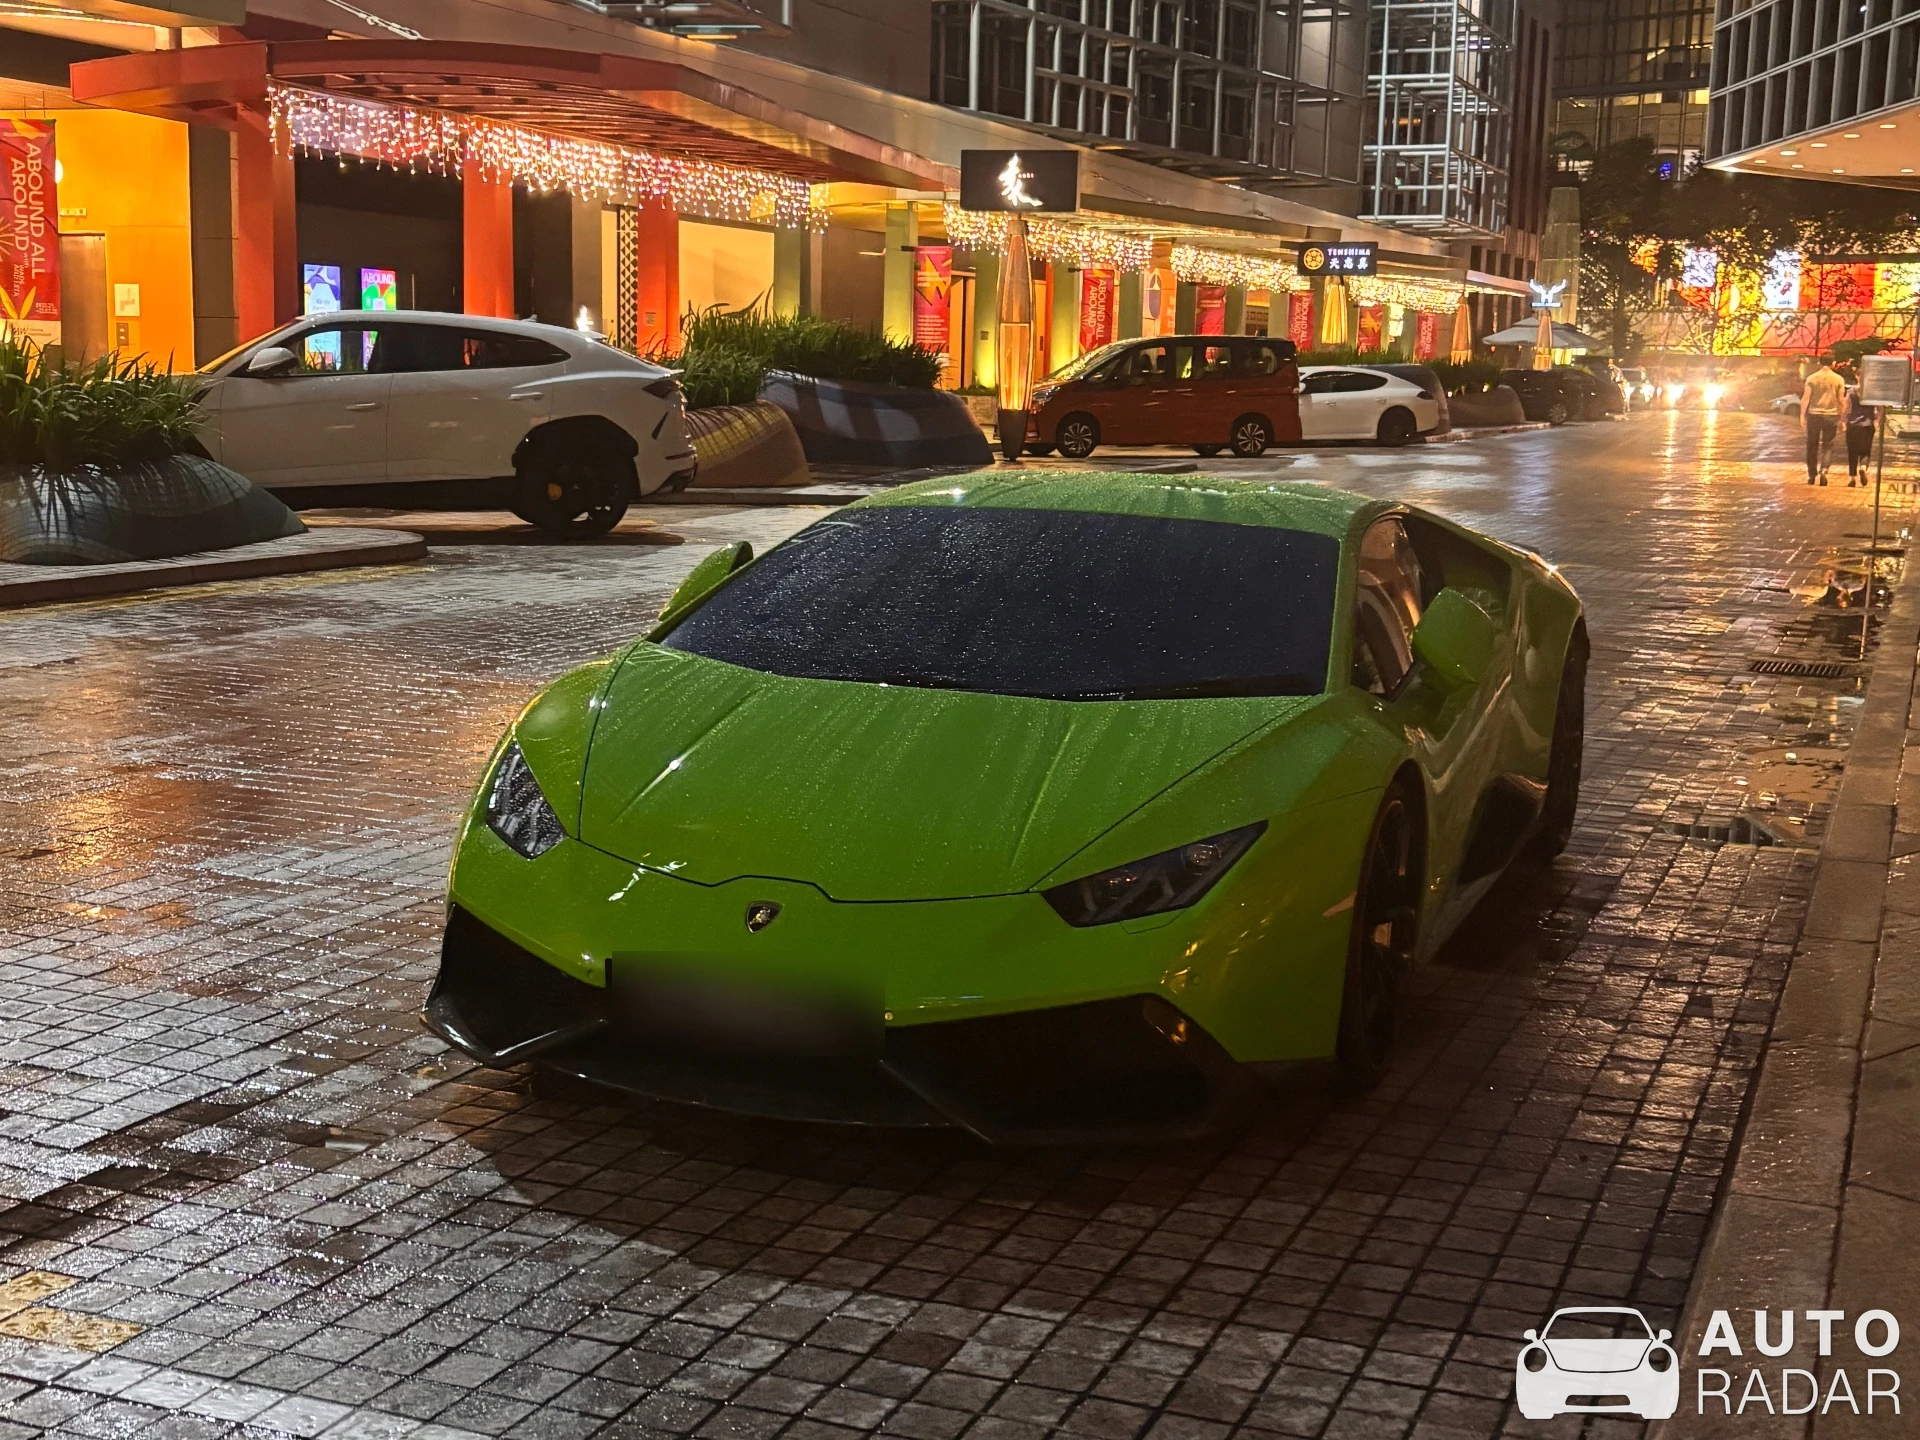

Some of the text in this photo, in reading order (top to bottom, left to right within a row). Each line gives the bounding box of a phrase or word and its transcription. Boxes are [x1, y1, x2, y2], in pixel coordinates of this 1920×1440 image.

[10, 157, 29, 251] AROUND
[27, 142, 46, 280] ABOUND ALL
[364, 272, 394, 285] ABOUND
[1088, 285, 1098, 328] AROUND
[1095, 279, 1107, 341] ABOUND ALL
